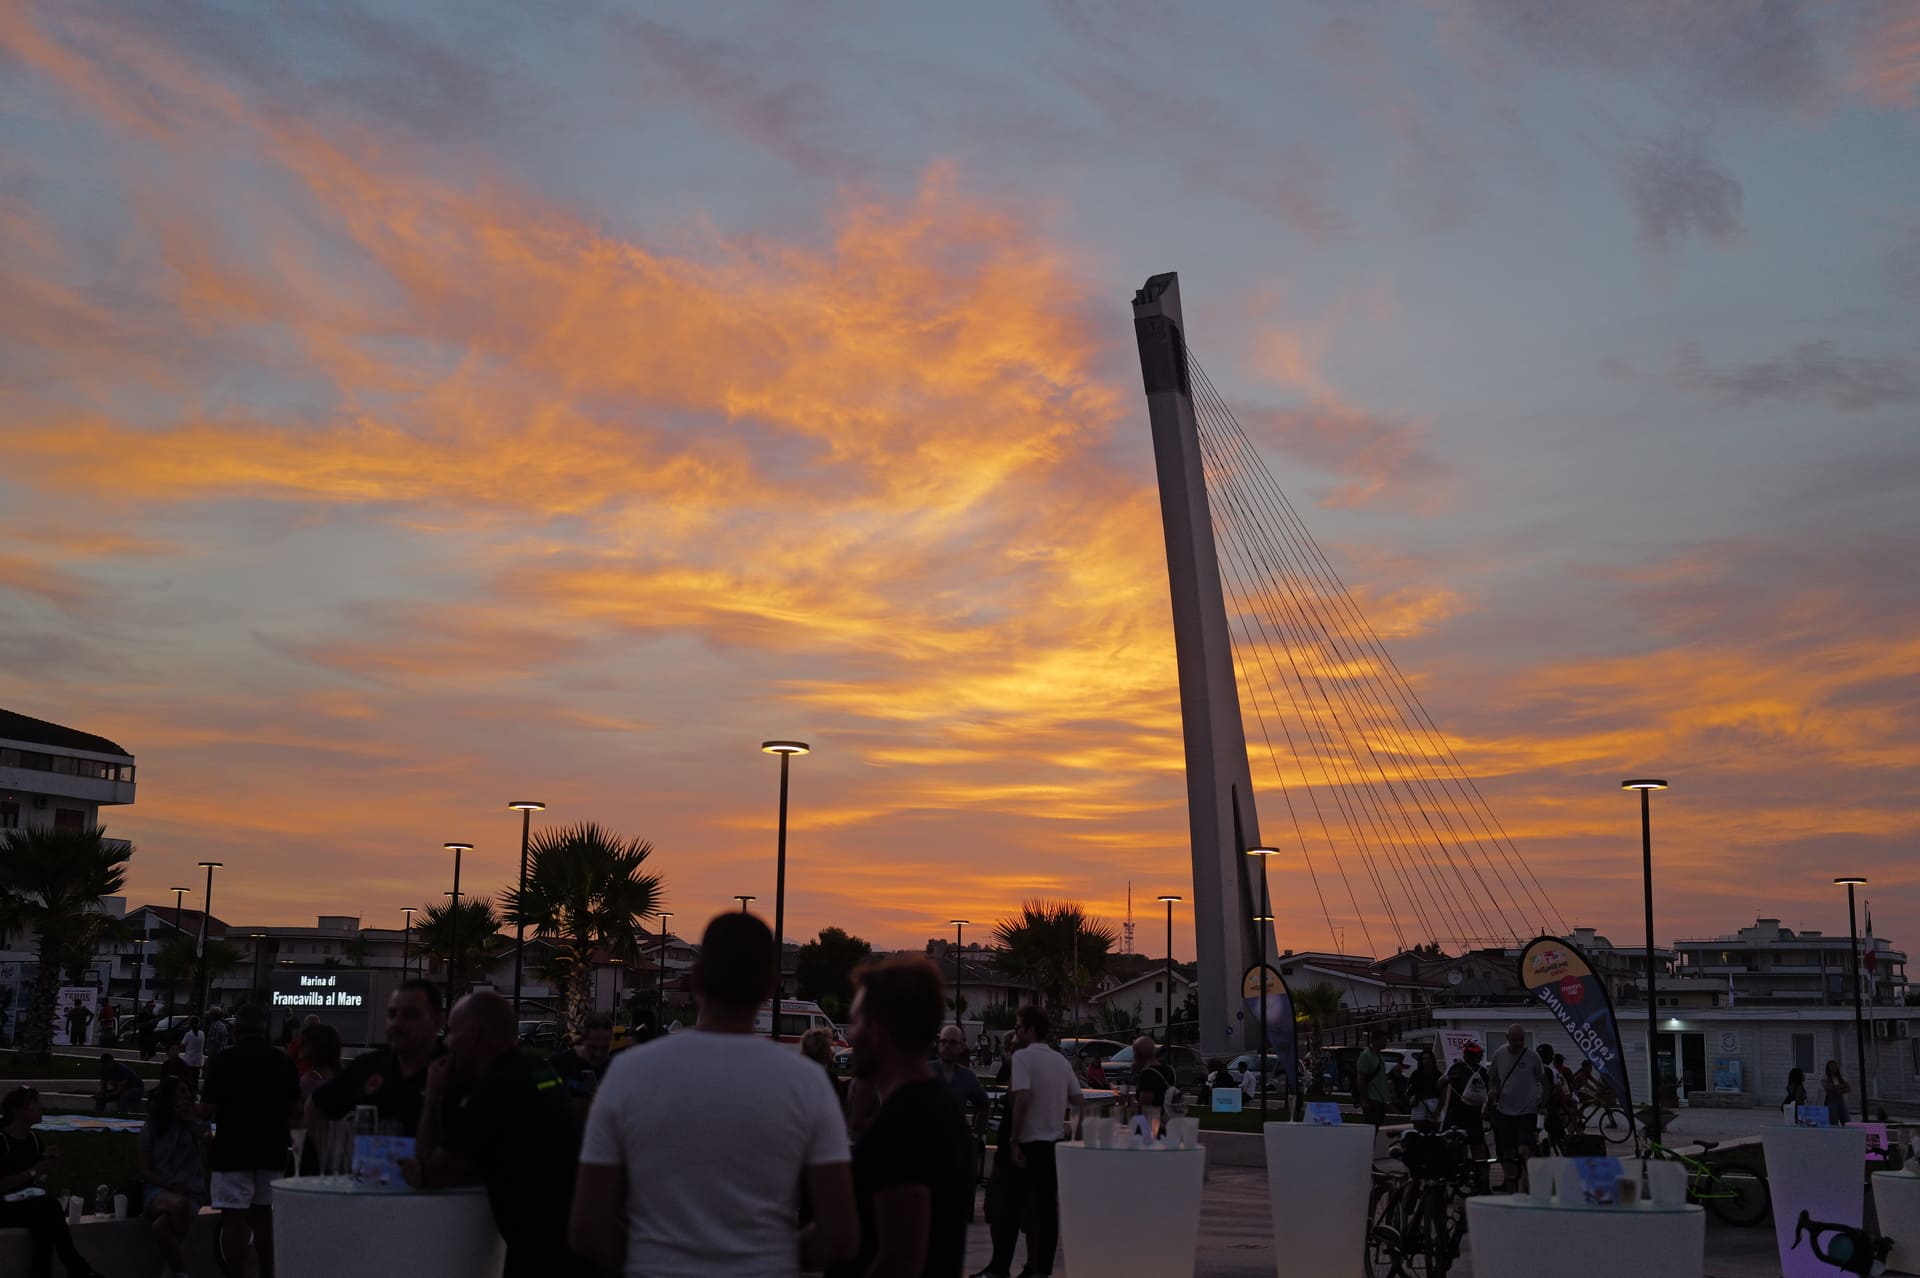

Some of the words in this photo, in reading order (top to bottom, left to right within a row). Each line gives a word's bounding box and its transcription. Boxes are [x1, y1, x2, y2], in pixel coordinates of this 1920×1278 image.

[300, 976, 326, 986] Marina
[328, 976, 336, 986] di
[273, 992, 323, 1005] Francavilla
[325, 992, 335, 1005] al
[337, 992, 362, 1005] Mare
